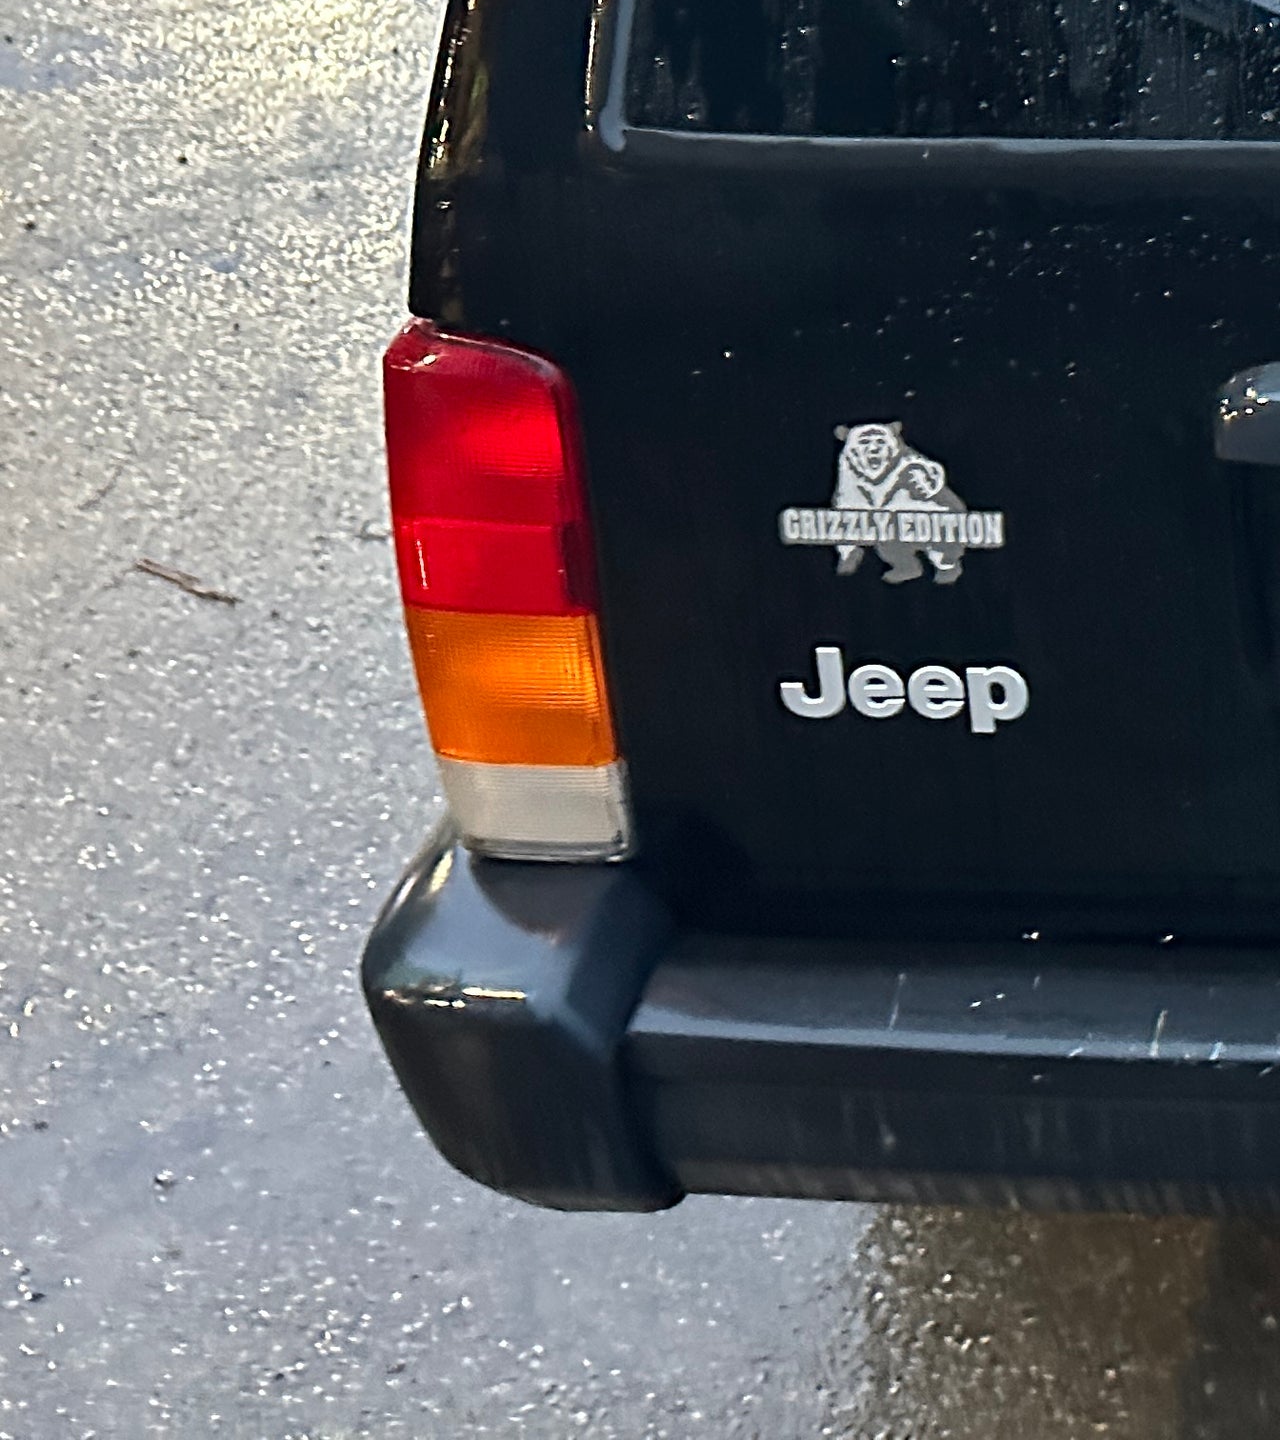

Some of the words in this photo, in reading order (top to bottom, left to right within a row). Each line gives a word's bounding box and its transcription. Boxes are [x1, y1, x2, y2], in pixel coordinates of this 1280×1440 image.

[782, 509, 889, 542] GRIZZLY
[898, 512, 1004, 545] EDITION
[780, 646, 1029, 734] Jeep
